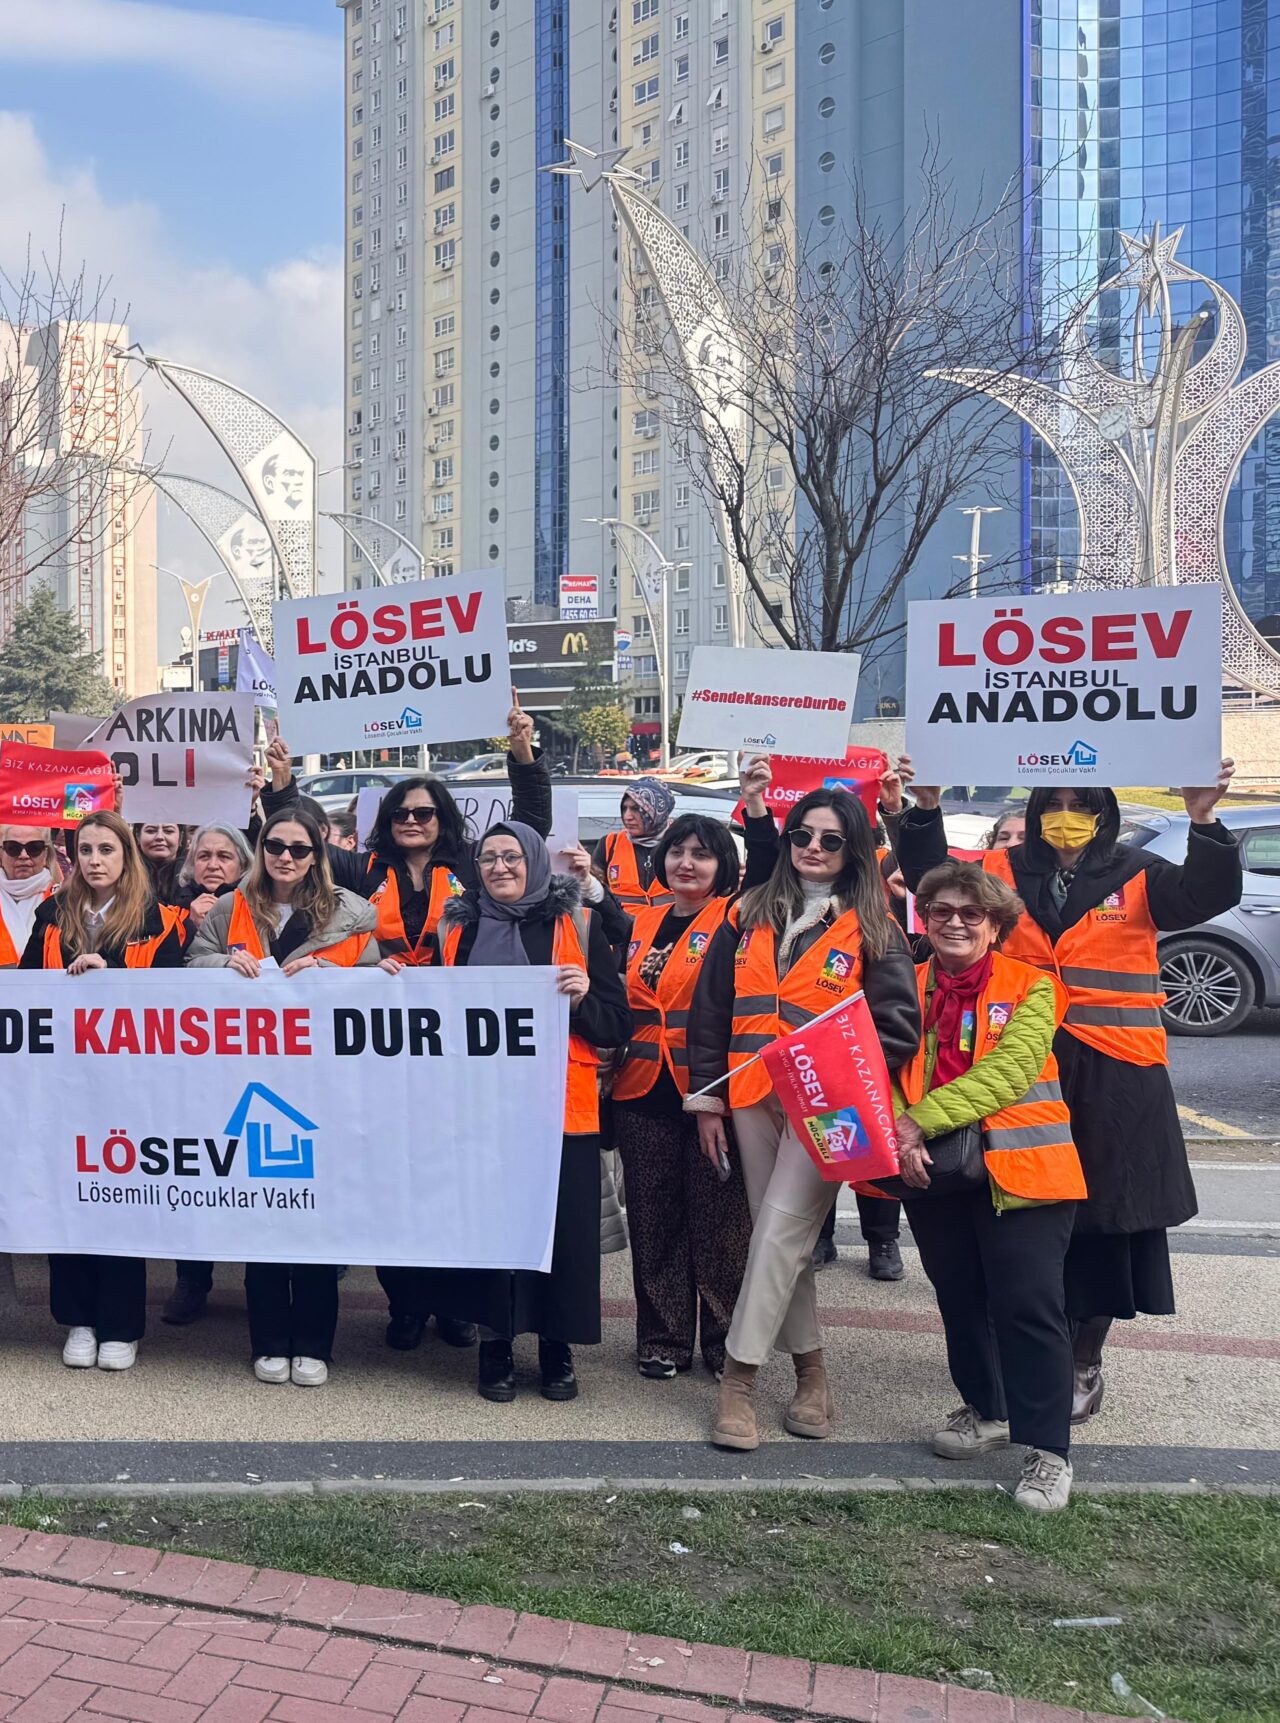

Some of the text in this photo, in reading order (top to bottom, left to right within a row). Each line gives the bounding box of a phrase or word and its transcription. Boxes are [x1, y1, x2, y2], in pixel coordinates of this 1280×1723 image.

[568, 595, 591, 604] DEHA
[297, 591, 482, 655] LÖSEV
[938, 608, 1193, 667] LÖSEV
[334, 645, 440, 670] İSTANBUL
[294, 653, 492, 704] ANADOLU
[985, 668, 1128, 689] İSTANBUL
[691, 689, 847, 711] #SendeKansereDurDe
[927, 685, 1197, 723] ANADOLU
[87, 705, 240, 743] ARKINDA
[364, 720, 404, 733] LÖSEV
[4, 759, 112, 775] BİZ KAZANACAĞIZ
[1018, 753, 1072, 765] LÖSEV
[12, 794, 61, 809] LÖSEV
[764, 787, 808, 802] LÖSE
[1096, 913, 1127, 922] LÖSEV
[816, 977, 845, 994] LÖSEV
[74, 1007, 312, 1056] KANSERE
[333, 1008, 444, 1057] DUR
[465, 1007, 536, 1056] DE
[836, 1013, 856, 1041] BİZ
[789, 1043, 828, 1108] LÖSEV
[76, 1129, 239, 1177] LÖSEV
[807, 1121, 830, 1160] MÜCADELE
[78, 1182, 315, 1211] Lösemili Çocuklar Vakfı
